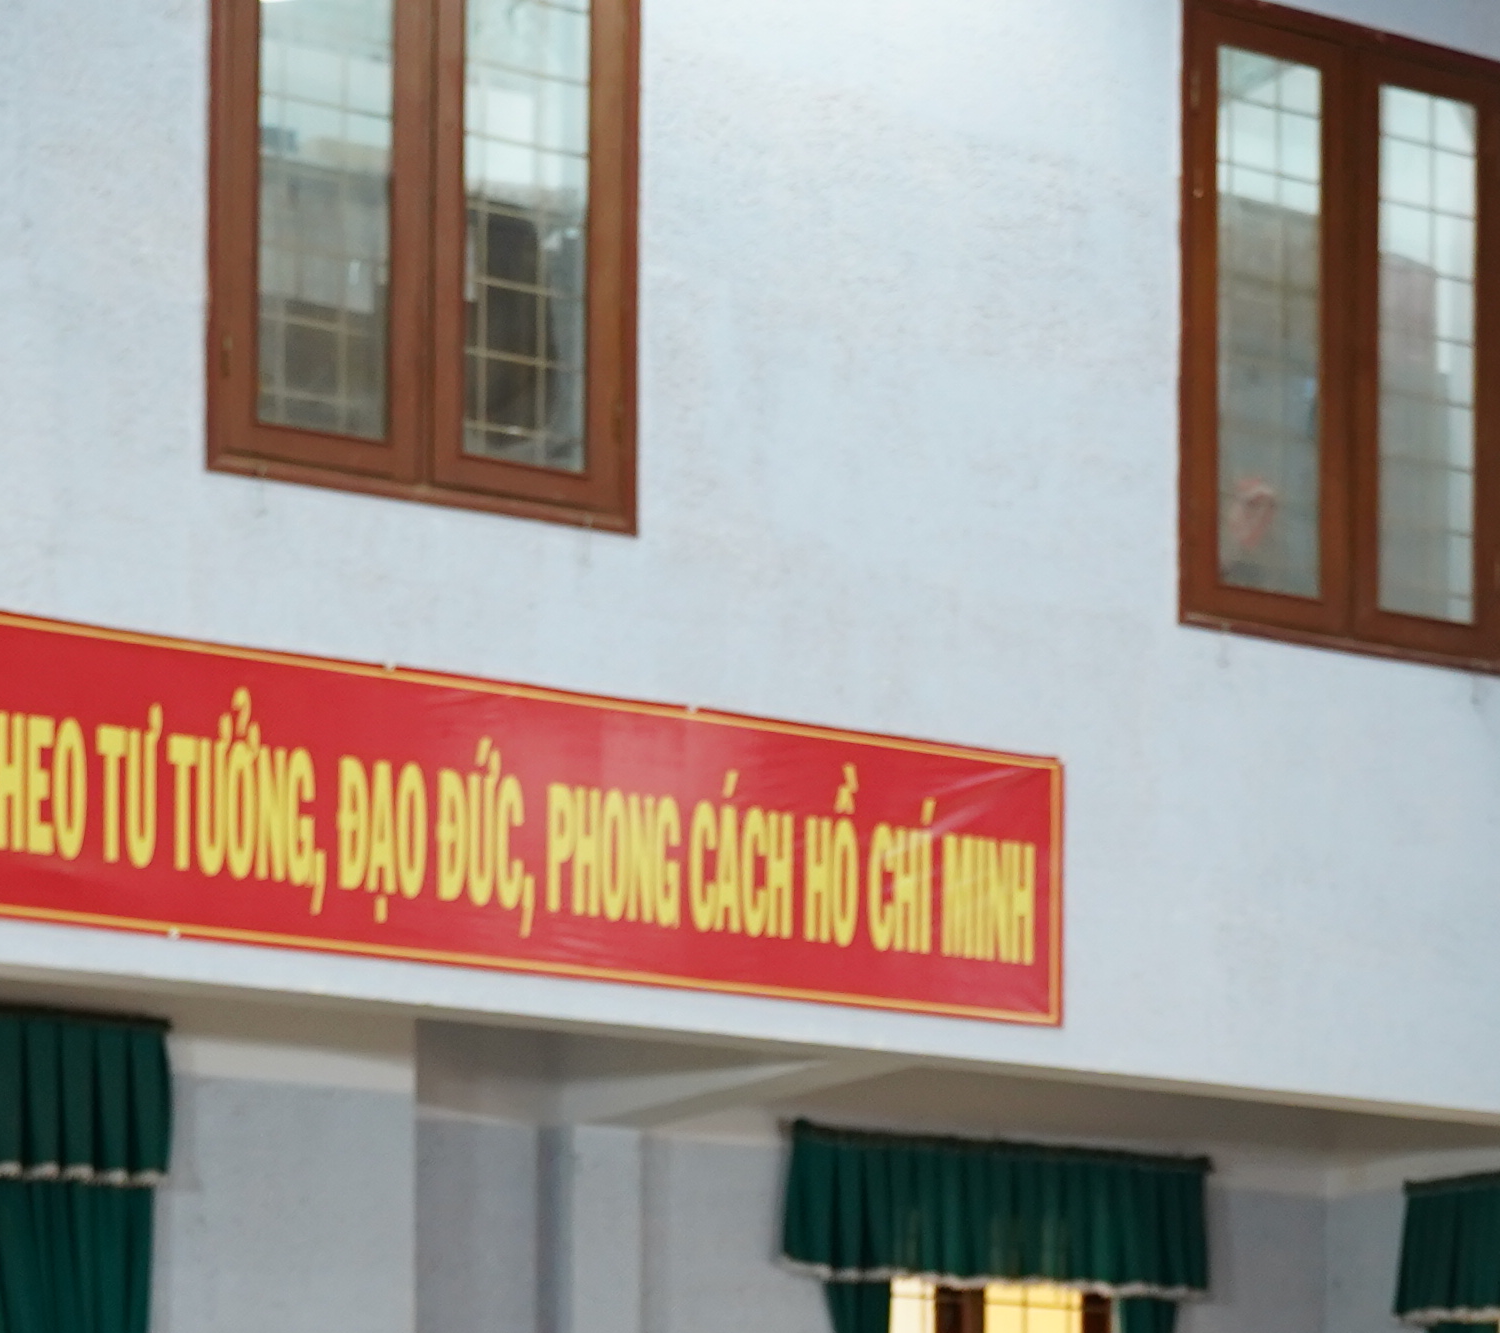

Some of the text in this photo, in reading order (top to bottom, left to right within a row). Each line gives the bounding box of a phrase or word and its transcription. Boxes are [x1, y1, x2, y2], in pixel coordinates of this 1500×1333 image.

[96, 705, 162, 868] TƯ
[168, 688, 326, 914] TƯỞNG,
[337, 756, 428, 923] ĐẠO
[435, 736, 536, 938] ĐỨC,
[545, 781, 682, 928] PHONG
[688, 770, 794, 939] CÁCH
[804, 764, 859, 947] HỒ
[867, 798, 935, 954] CHÍ
[941, 832, 1035, 965] MINH
